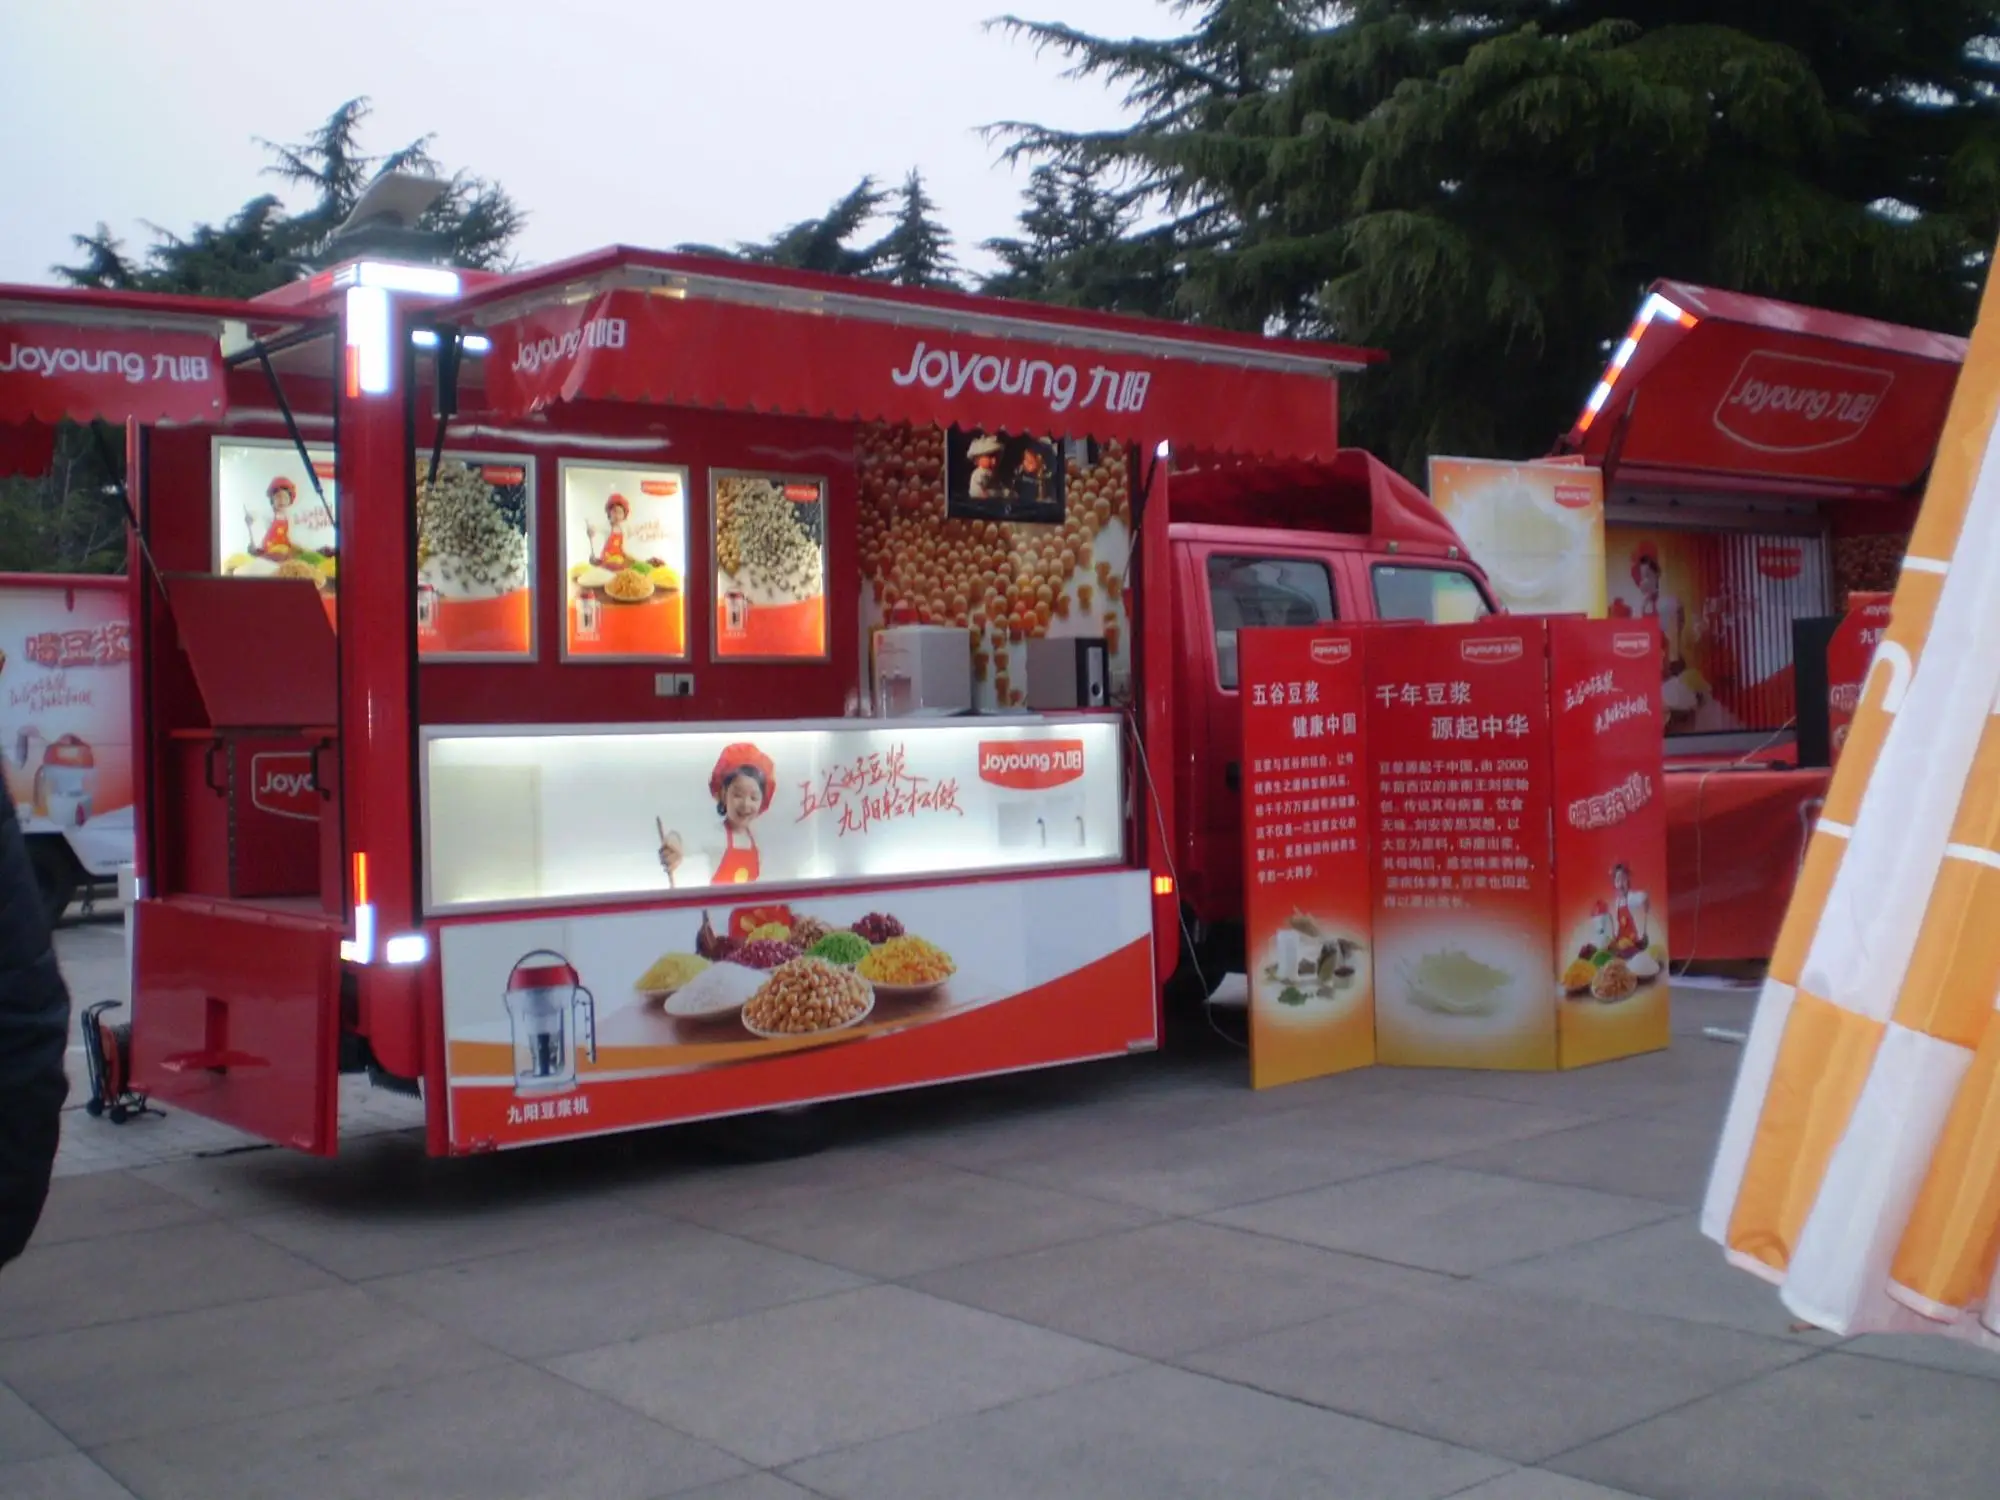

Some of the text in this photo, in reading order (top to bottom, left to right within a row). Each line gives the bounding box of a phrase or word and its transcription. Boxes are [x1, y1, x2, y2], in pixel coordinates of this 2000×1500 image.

[0, 342, 209, 383] Joyoung 九阳
[512, 328, 581, 373] Joyoung
[892, 342, 1150, 412] Joyoung 九阳
[1730, 377, 1876, 422] Joyoung 九阳
[1252, 680, 1320, 706] 五谷豆浆
[1376, 681, 1472, 708] 千年豆浆
[1292, 712, 1357, 739] 健康中国
[1431, 714, 1530, 740] 源起中华
[982, 751, 1081, 773] Joyoung 九阳
[507, 1095, 589, 1126] 九阳豆浆机
